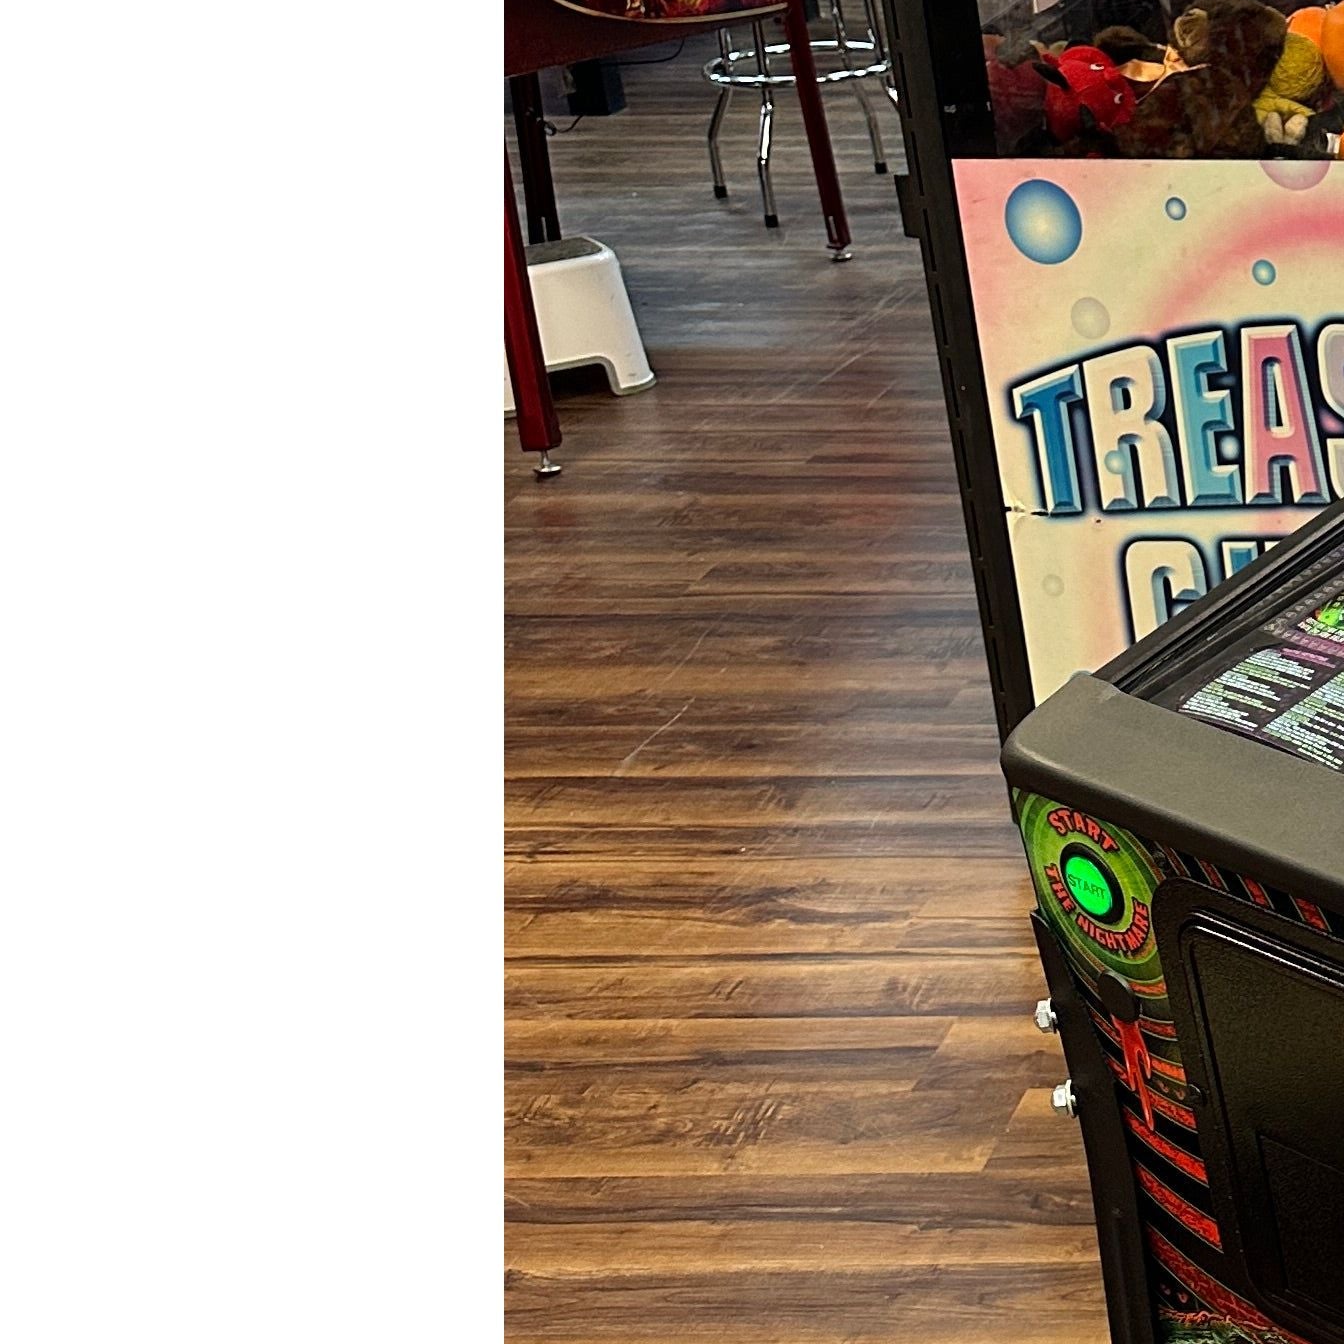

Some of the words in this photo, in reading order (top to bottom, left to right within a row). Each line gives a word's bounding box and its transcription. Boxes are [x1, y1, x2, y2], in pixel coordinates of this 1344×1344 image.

[1047, 806, 1120, 853] START
[1044, 863, 1077, 913] THE
[1075, 896, 1151, 953] NIGHTMARE
[1067, 873, 1106, 900] START
